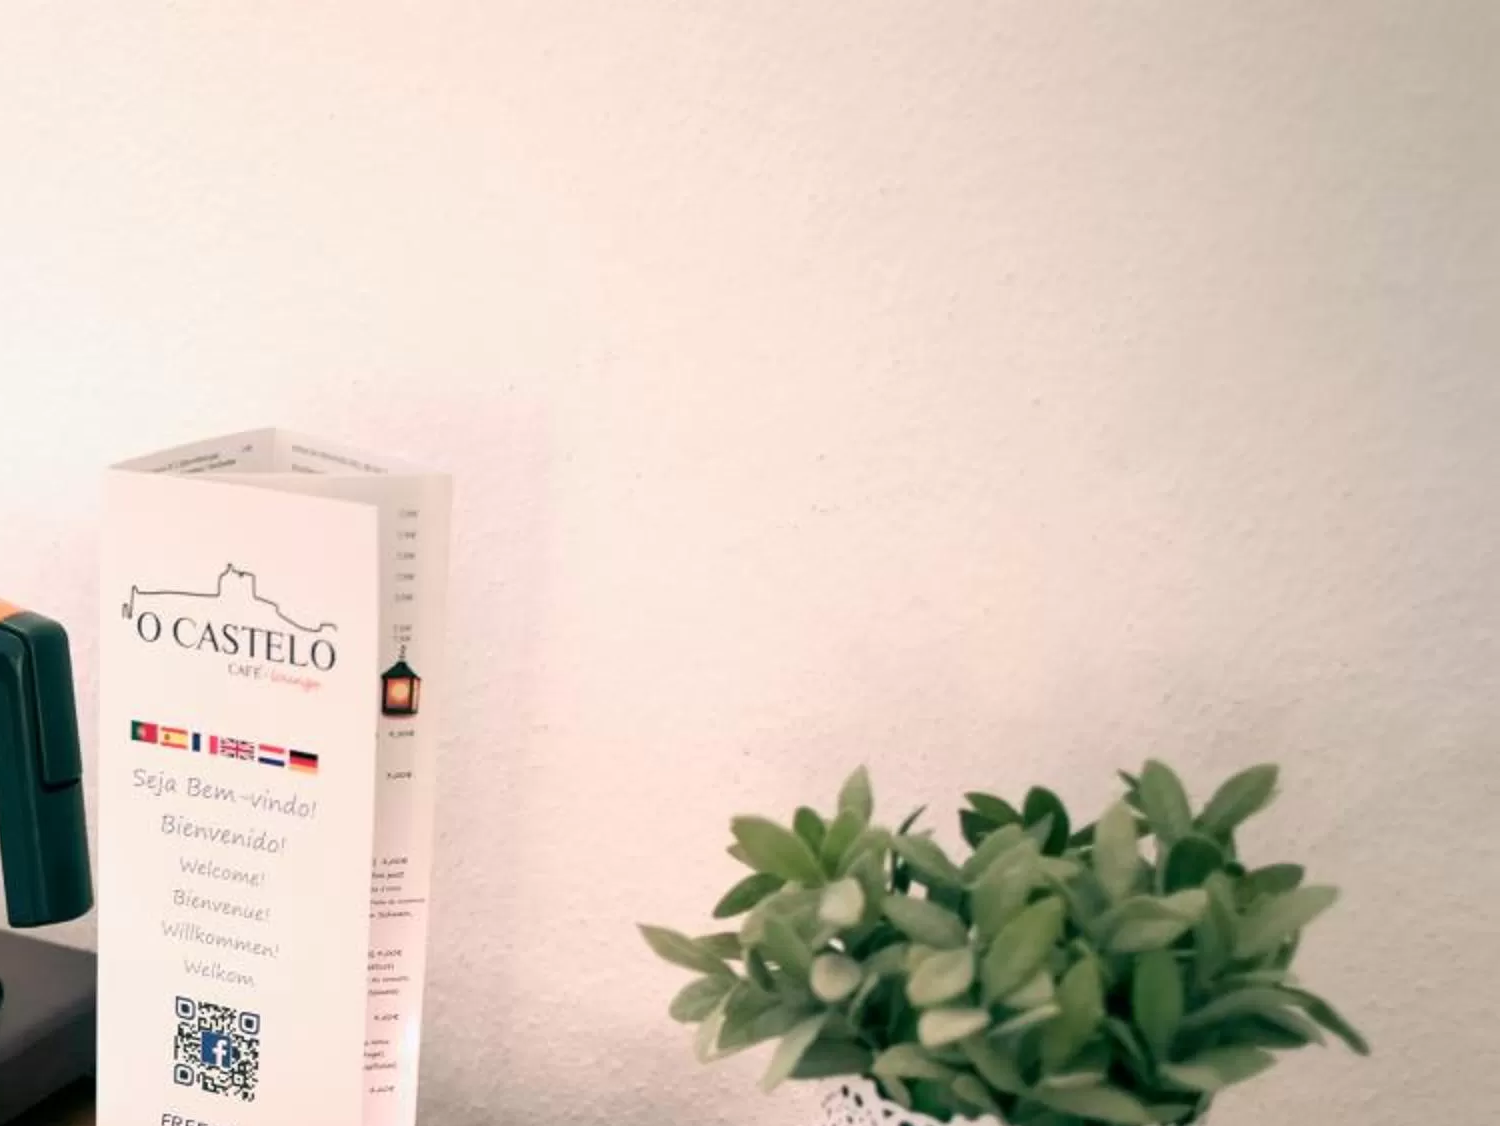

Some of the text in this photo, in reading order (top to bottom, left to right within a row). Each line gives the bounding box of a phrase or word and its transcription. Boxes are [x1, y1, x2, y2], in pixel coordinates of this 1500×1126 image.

[136, 611, 337, 671] O CASTELO
[132, 768, 317, 819] Seja Bem-vindo!
[160, 813, 287, 853] Bienvenido!
[179, 856, 266, 887] Welcome!
[172, 889, 271, 921] Bienvenue!
[160, 920, 280, 958] Willkommen!
[183, 959, 255, 986] Welkom
